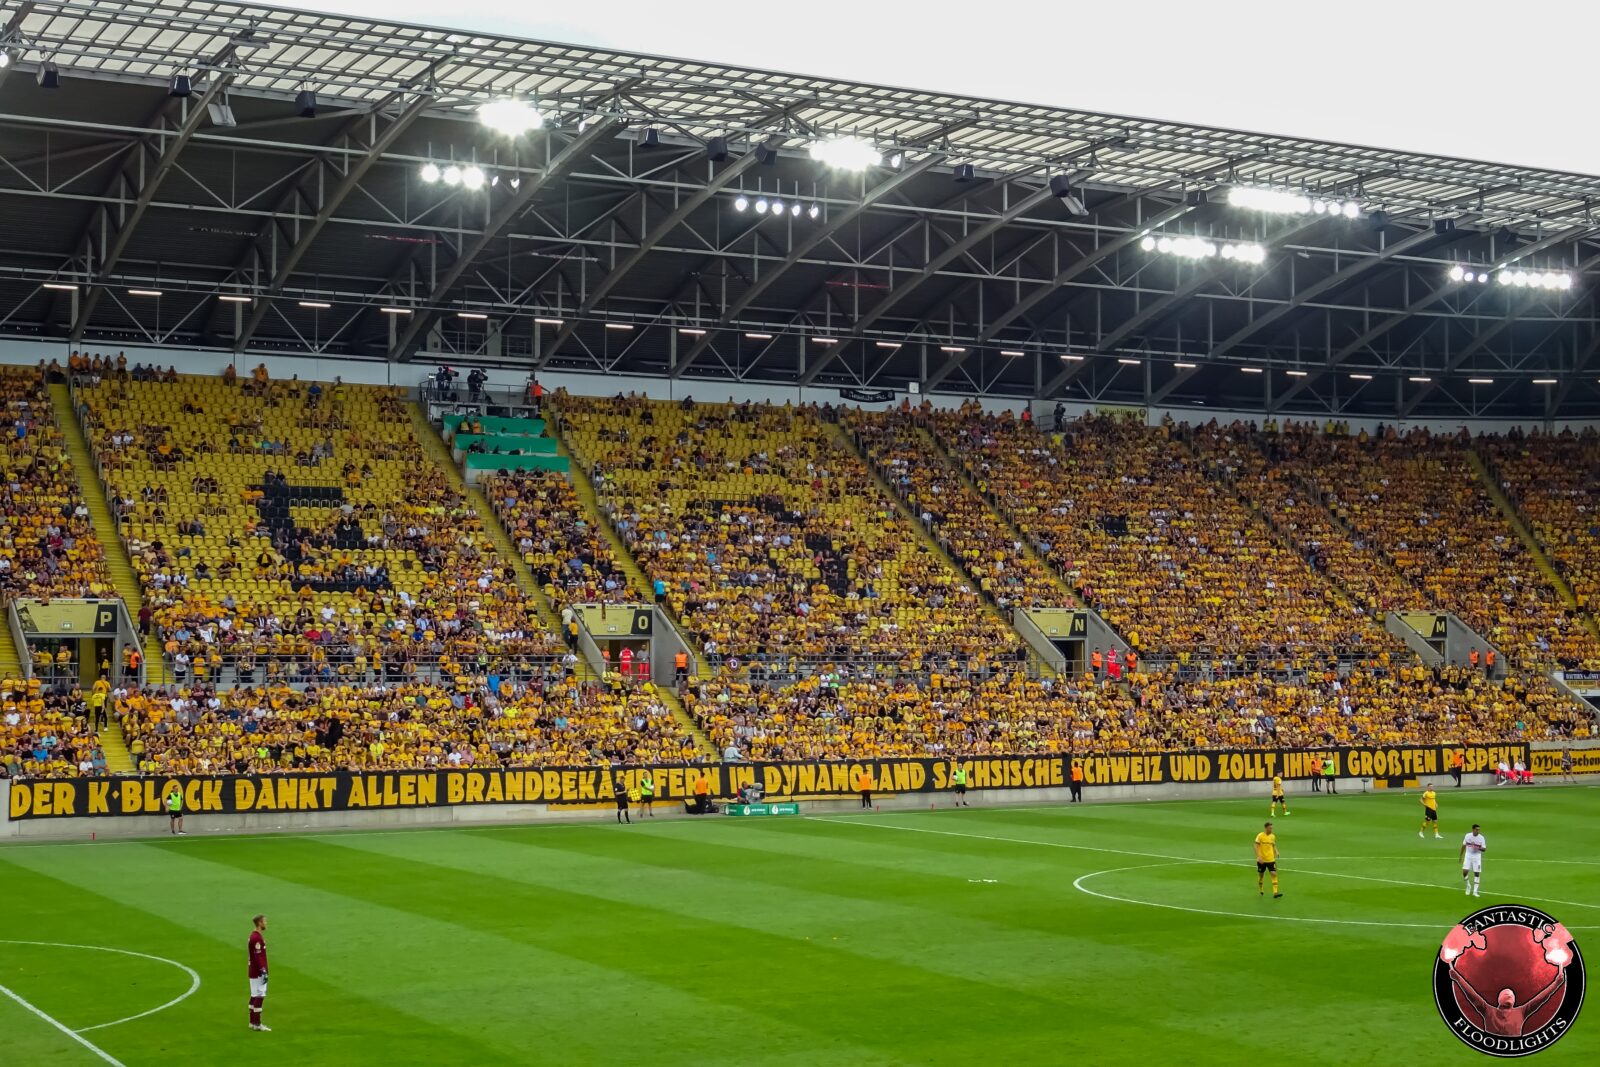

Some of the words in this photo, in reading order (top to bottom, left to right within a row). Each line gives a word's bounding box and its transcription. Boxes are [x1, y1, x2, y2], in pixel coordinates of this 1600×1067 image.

[100, 611, 112, 627] P
[638, 615, 648, 630] O
[1074, 618, 1084, 632] N
[1436, 621, 1445, 633] M
[10, 782, 76, 818] DER
[235, 777, 337, 810] DANKT
[347, 773, 437, 807] ALLEN
[763, 762, 926, 796] DYNAMOLAND
[1169, 753, 1211, 781] UND
[1218, 753, 1276, 780] ZOLLT
